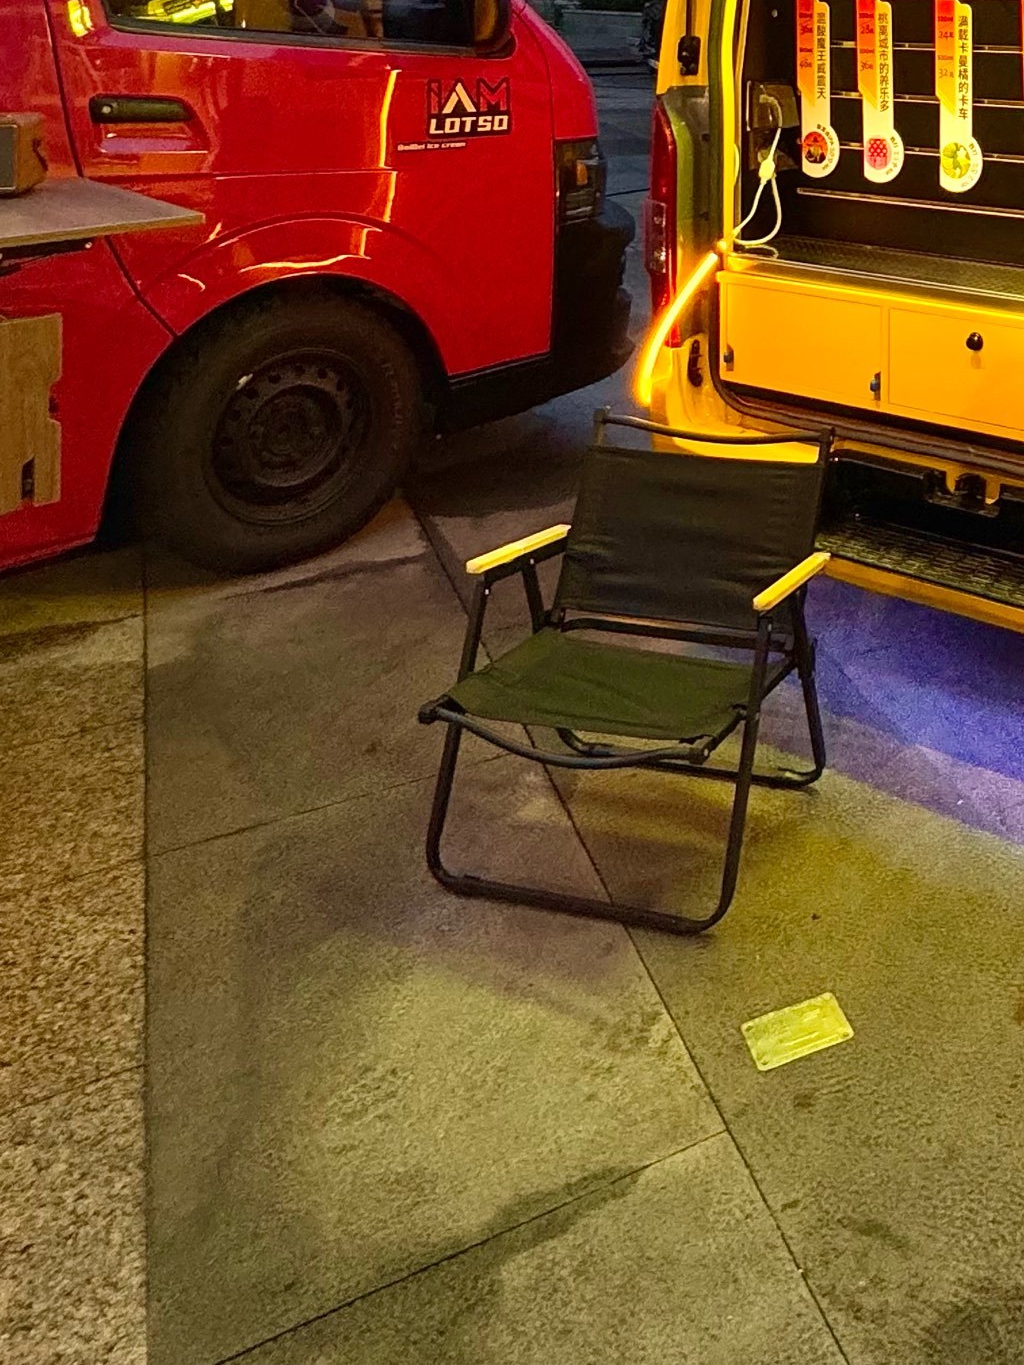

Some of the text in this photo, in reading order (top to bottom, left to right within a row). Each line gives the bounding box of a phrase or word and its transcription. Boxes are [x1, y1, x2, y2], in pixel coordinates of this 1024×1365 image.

[957, 15, 969, 121] 满载卡曼橘的卡车
[428, 114, 510, 135] LOTSO
